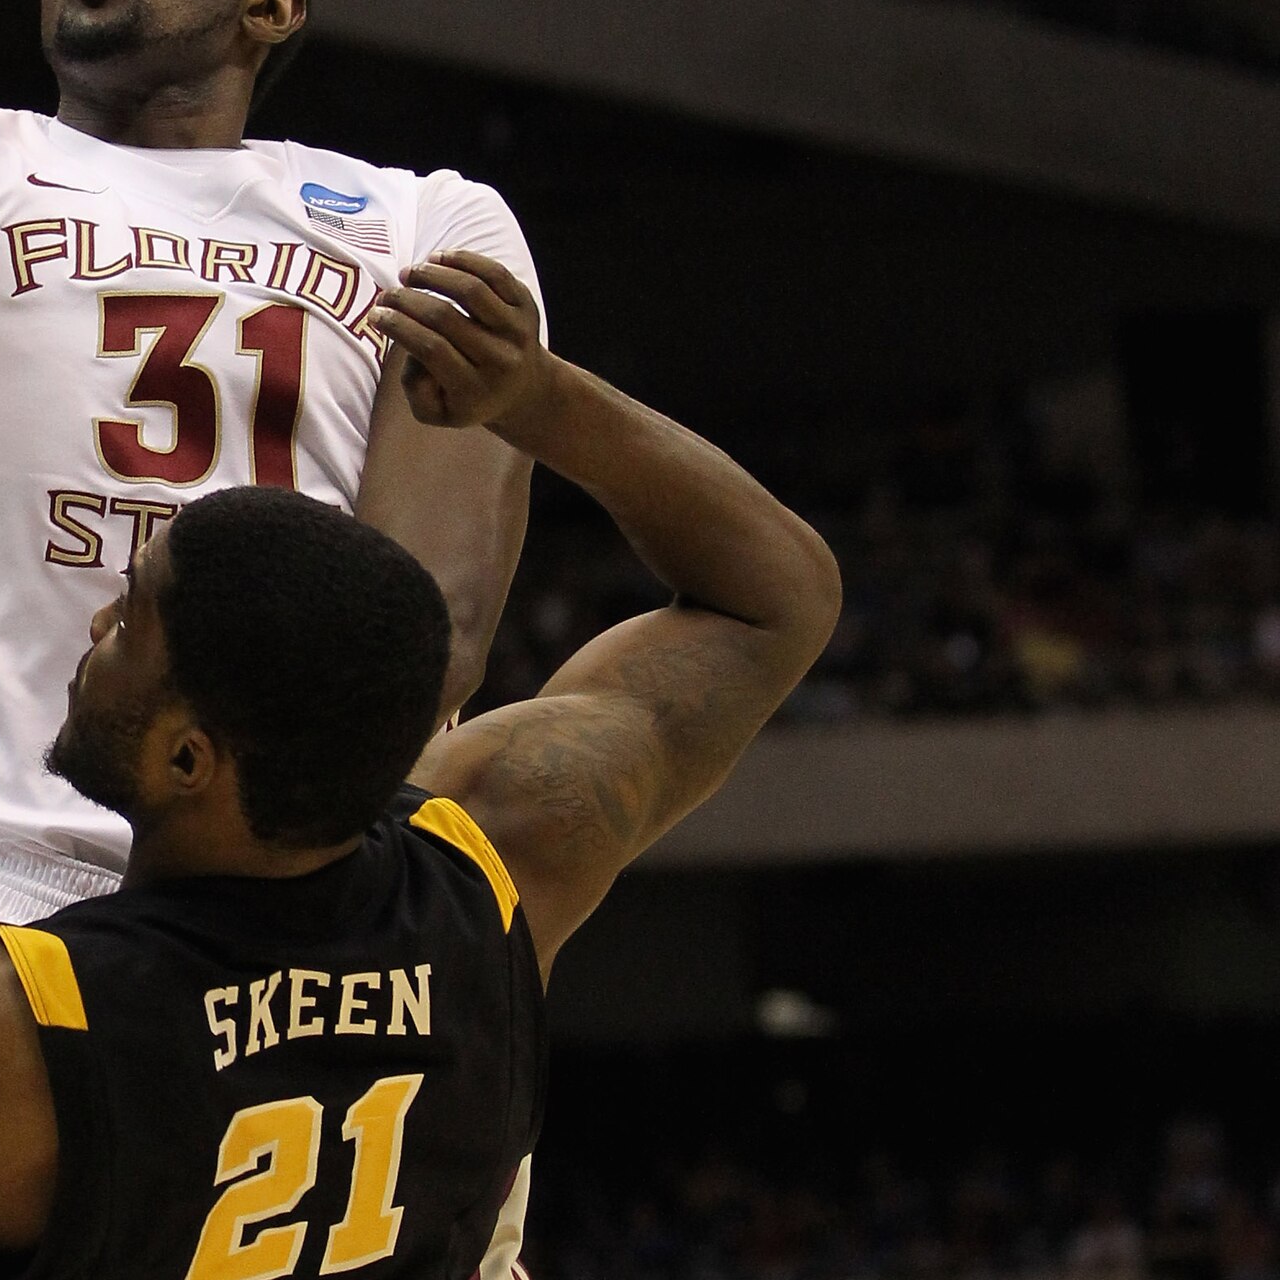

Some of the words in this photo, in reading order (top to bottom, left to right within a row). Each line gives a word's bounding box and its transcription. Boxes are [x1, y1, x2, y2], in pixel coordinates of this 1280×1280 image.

[309, 196, 361, 208] NCAA
[1, 217, 392, 367] FLORIDA
[92, 291, 310, 492] 31
[203, 963, 433, 1072] SKEEN
